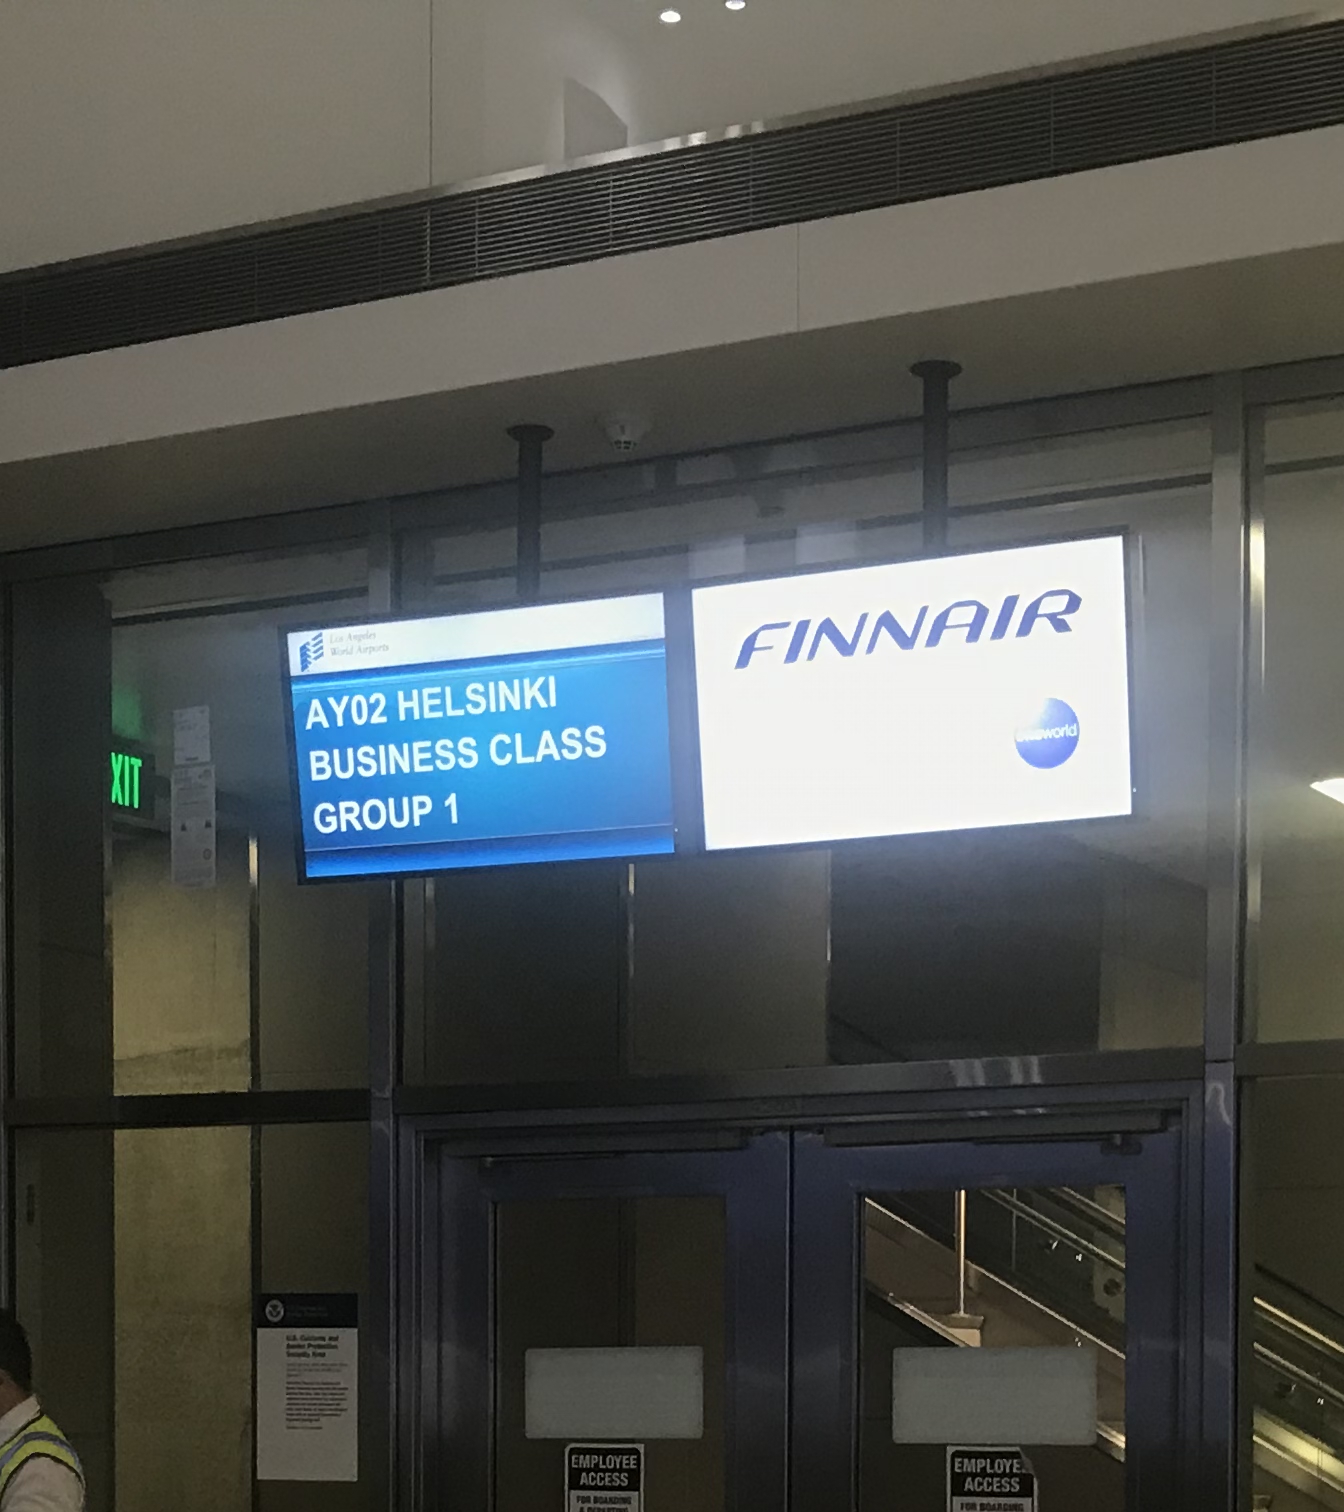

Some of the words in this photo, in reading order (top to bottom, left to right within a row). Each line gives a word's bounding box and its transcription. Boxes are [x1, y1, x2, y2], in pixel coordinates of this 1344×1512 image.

[734, 589, 1083, 670] FINNAIR
[305, 691, 388, 731] AY02
[399, 676, 558, 722] HELSINKI
[310, 736, 477, 782] BUSINESS
[489, 726, 607, 767] CLASS
[111, 752, 142, 808] XIT
[313, 799, 433, 835] GROUP
[444, 794, 460, 824] 1
[571, 1454, 637, 1469] EMPLOYEE
[579, 1471, 629, 1486] ACCESS
[963, 1476, 1020, 1492] ACCESS
[960, 1502, 977, 1511] FOR
